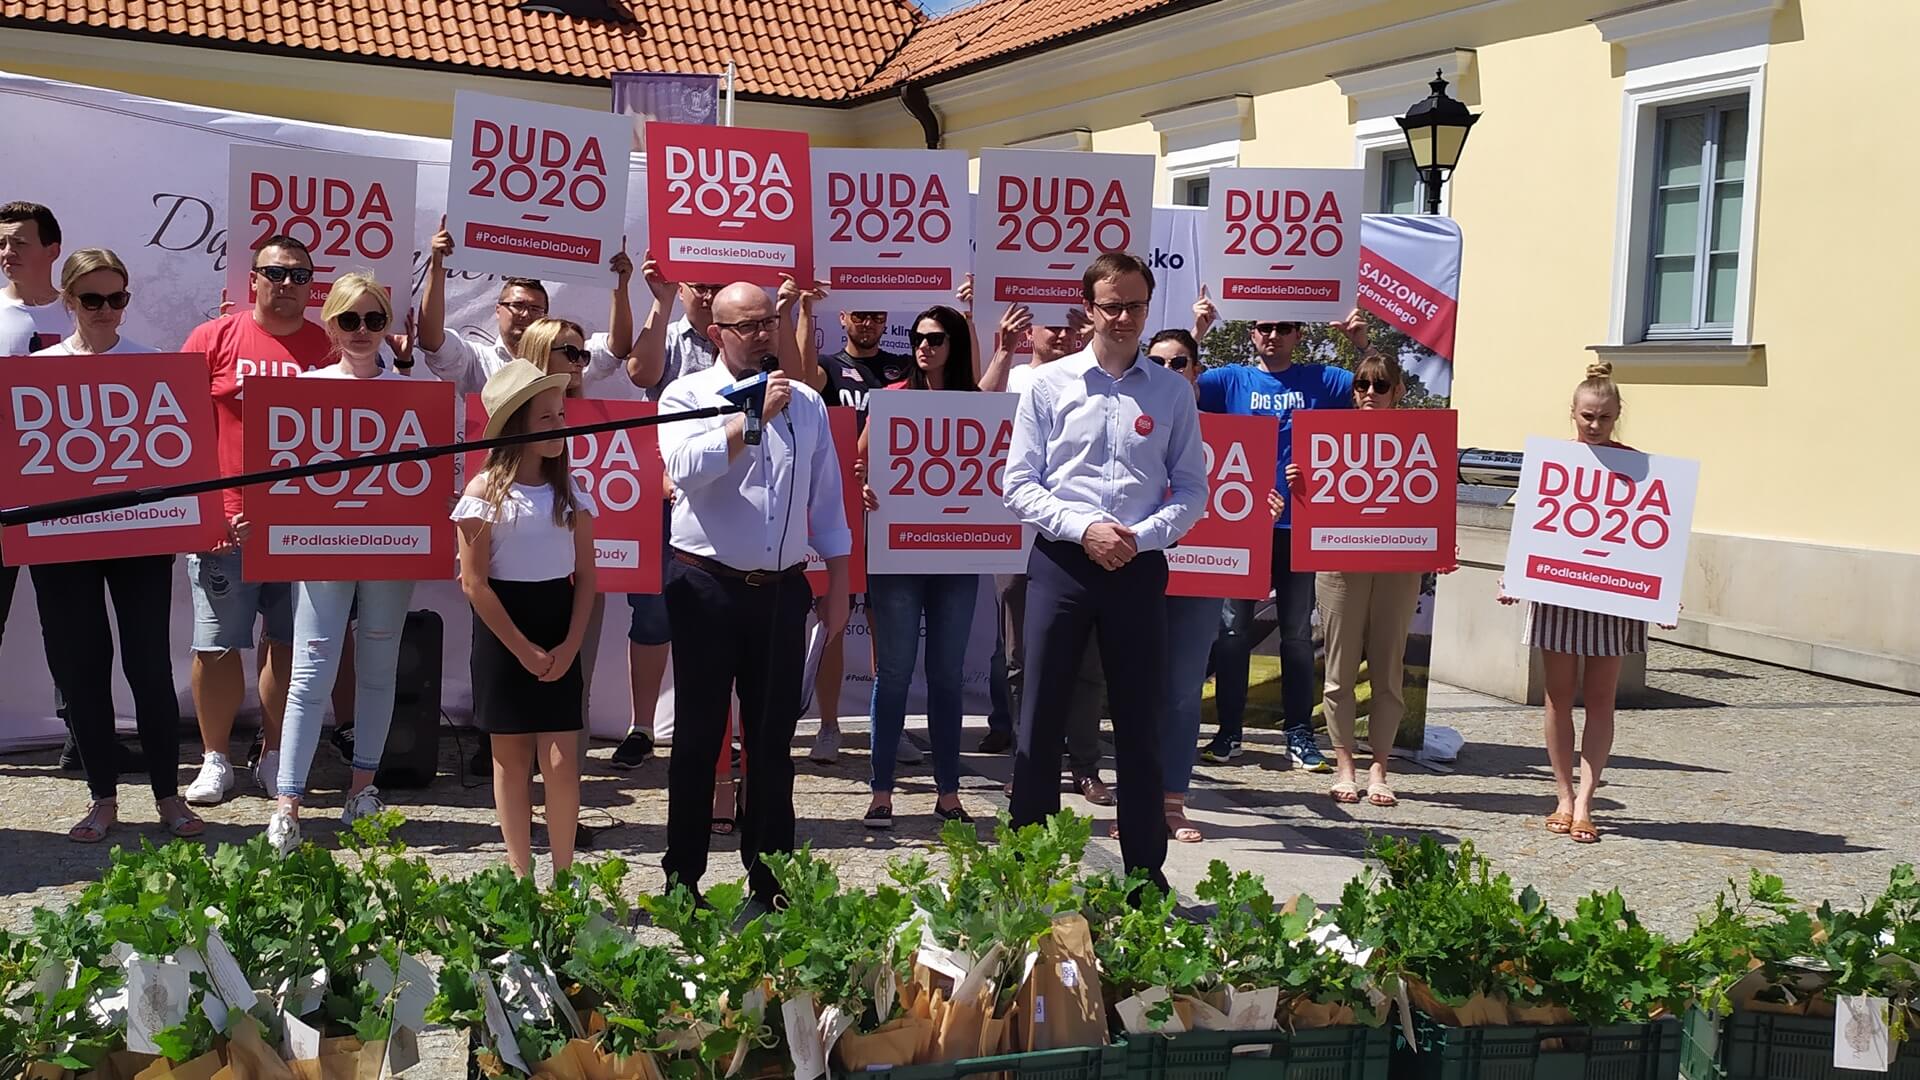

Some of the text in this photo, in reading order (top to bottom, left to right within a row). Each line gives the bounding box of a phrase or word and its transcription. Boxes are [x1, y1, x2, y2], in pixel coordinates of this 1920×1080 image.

[471, 119, 607, 176] DUDA
[665, 145, 793, 187] DUDA
[250, 172, 393, 222] DUDA
[469, 159, 607, 213] 2020
[667, 180, 794, 221] 2020
[828, 172, 949, 209] DUDA
[998, 175, 1131, 218] DUDA
[829, 206, 952, 244] 2020
[1225, 189, 1343, 224] DUDA
[249, 212, 394, 260] 2020
[475, 231, 592, 257] #PodlaskieDlaDudy
[679, 244, 787, 261] #PodlaskieDlaDudy
[996, 214, 1131, 254] 2020
[1224, 221, 1343, 257] 2020
[839, 272, 943, 287] #PodlaskieDlaDudy
[1005, 285, 1084, 298] #PodlaskieDl
[1231, 283, 1332, 298] #PodlaskieDlaDudy
[1360, 263, 1438, 320] SADZONKĘ
[1358, 282, 1417, 325] denckiego
[11, 381, 187, 432] DUDA
[1250, 391, 1271, 410] BIG
[20, 424, 192, 475] 2020
[269, 406, 429, 453] DUDA
[889, 416, 1013, 457] DUDA
[1311, 432, 1438, 470] DUDA
[269, 450, 432, 496] 2020
[1311, 467, 1439, 504] 2020
[1538, 461, 1671, 517] DUDA
[282, 533, 419, 549] #PodlaskieDlaDudy
[899, 531, 1013, 545] #PodlaskieDlaDudy
[1320, 533, 1429, 548] #PodlaskieDlaDudy
[1532, 496, 1670, 550] 2020
[1536, 563, 1652, 593] #PodlaskieDlaDudy
